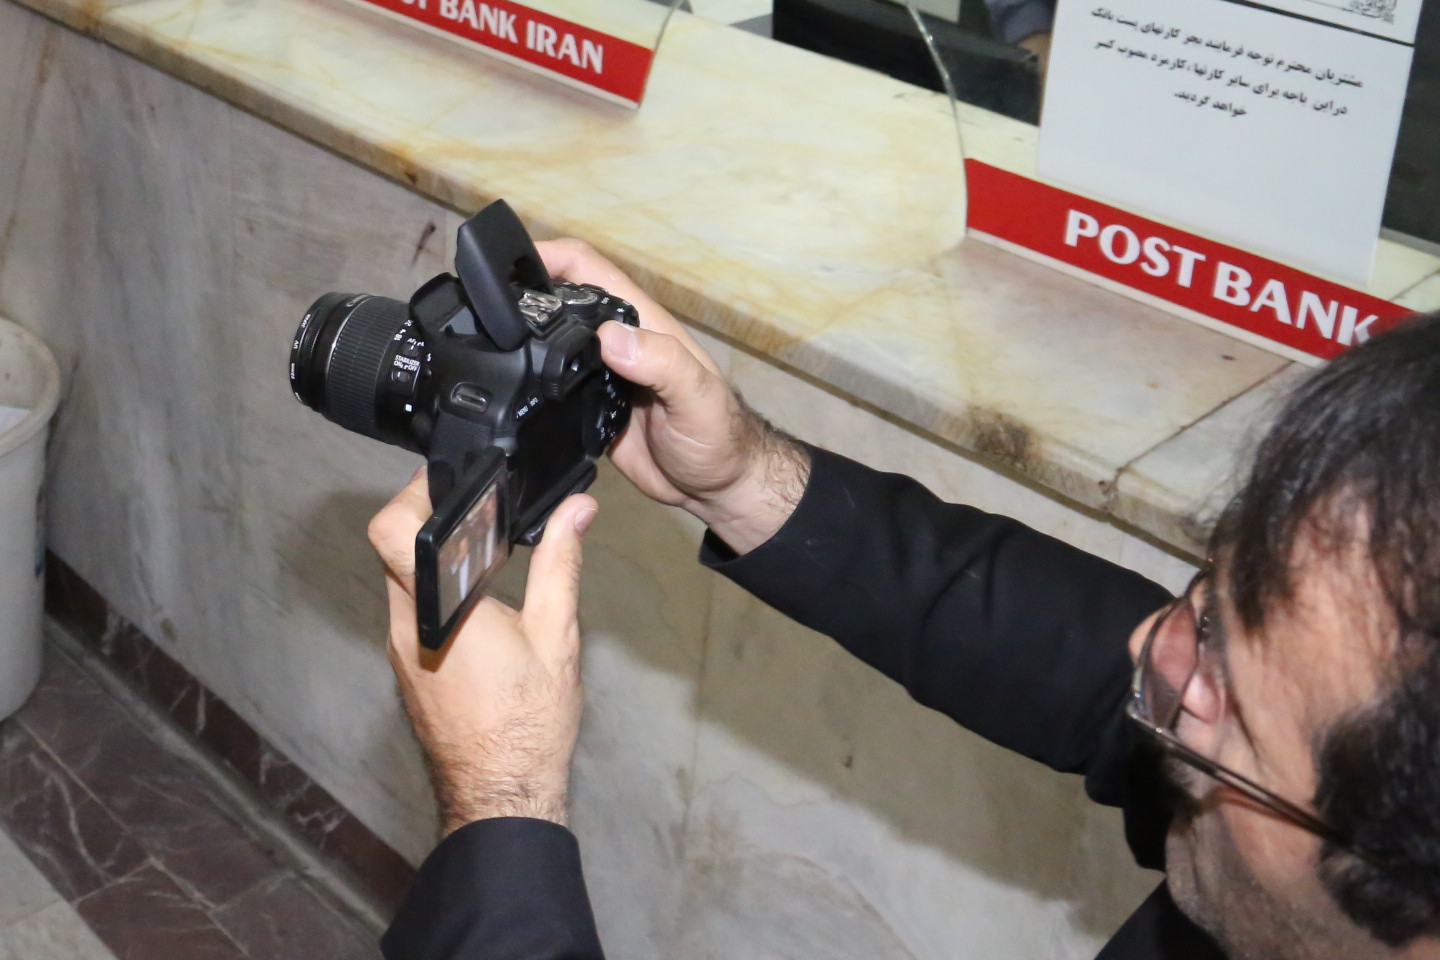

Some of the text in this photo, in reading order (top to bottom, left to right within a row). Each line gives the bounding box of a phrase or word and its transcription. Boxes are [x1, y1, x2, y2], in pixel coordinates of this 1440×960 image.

[1091, 7, 1114, 20] بانک
[1116, 18, 1138, 27] پست
[526, 20, 604, 75] IRAN
[1246, 51, 1273, 66] توجه
[1276, 59, 1311, 74] محترم
[1314, 68, 1362, 87] مشتریان
[1252, 82, 1279, 98] برای
[1063, 208, 1380, 347] POST BANK
[394, 354, 420, 367] STABILIZER
